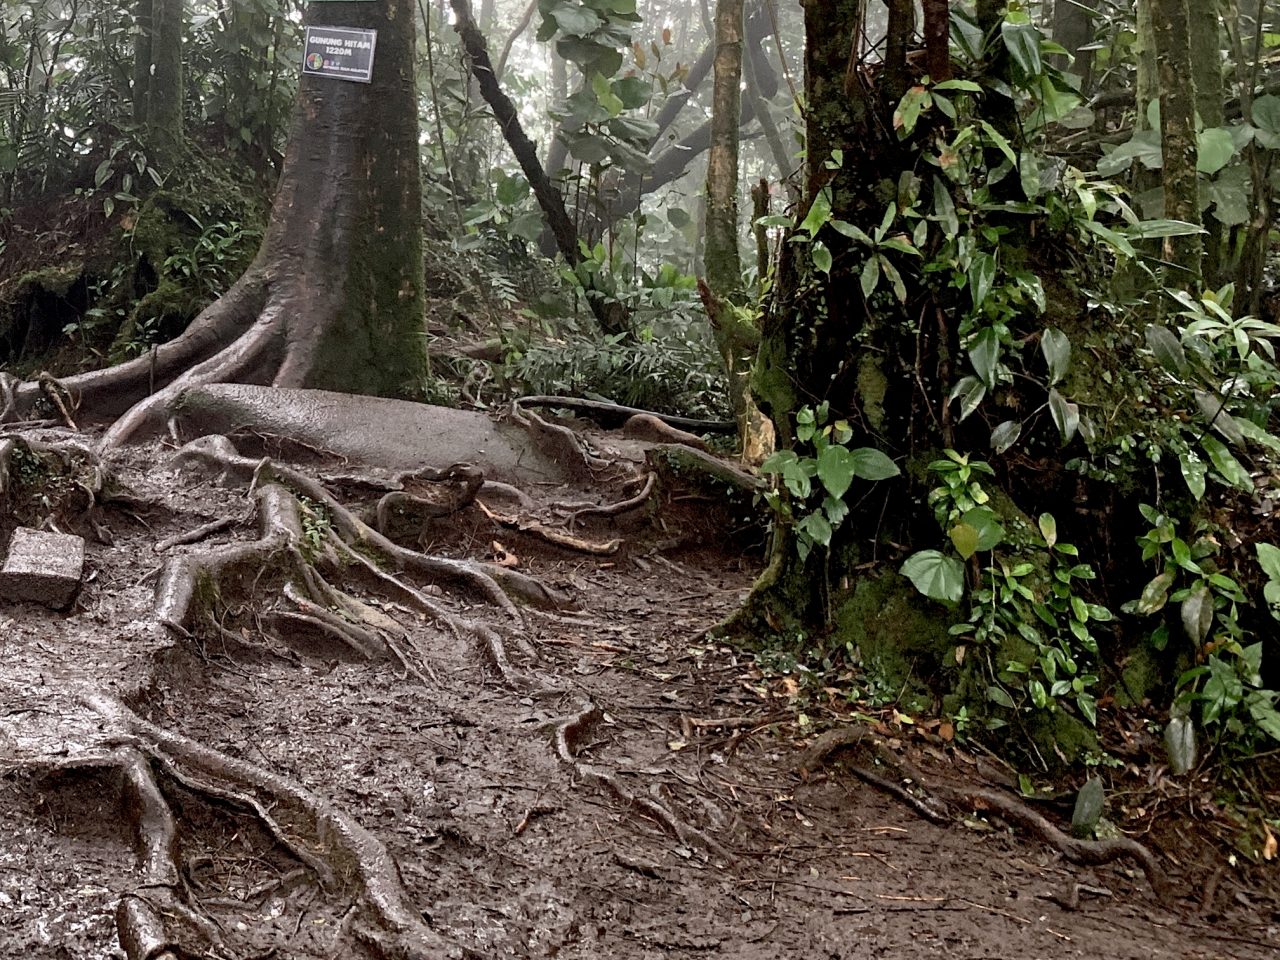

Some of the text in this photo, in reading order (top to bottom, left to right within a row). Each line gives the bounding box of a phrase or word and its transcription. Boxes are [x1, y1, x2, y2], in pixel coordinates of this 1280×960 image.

[309, 36, 371, 49] GUNUNG HITAM
[325, 46, 353, 56] 1220M
